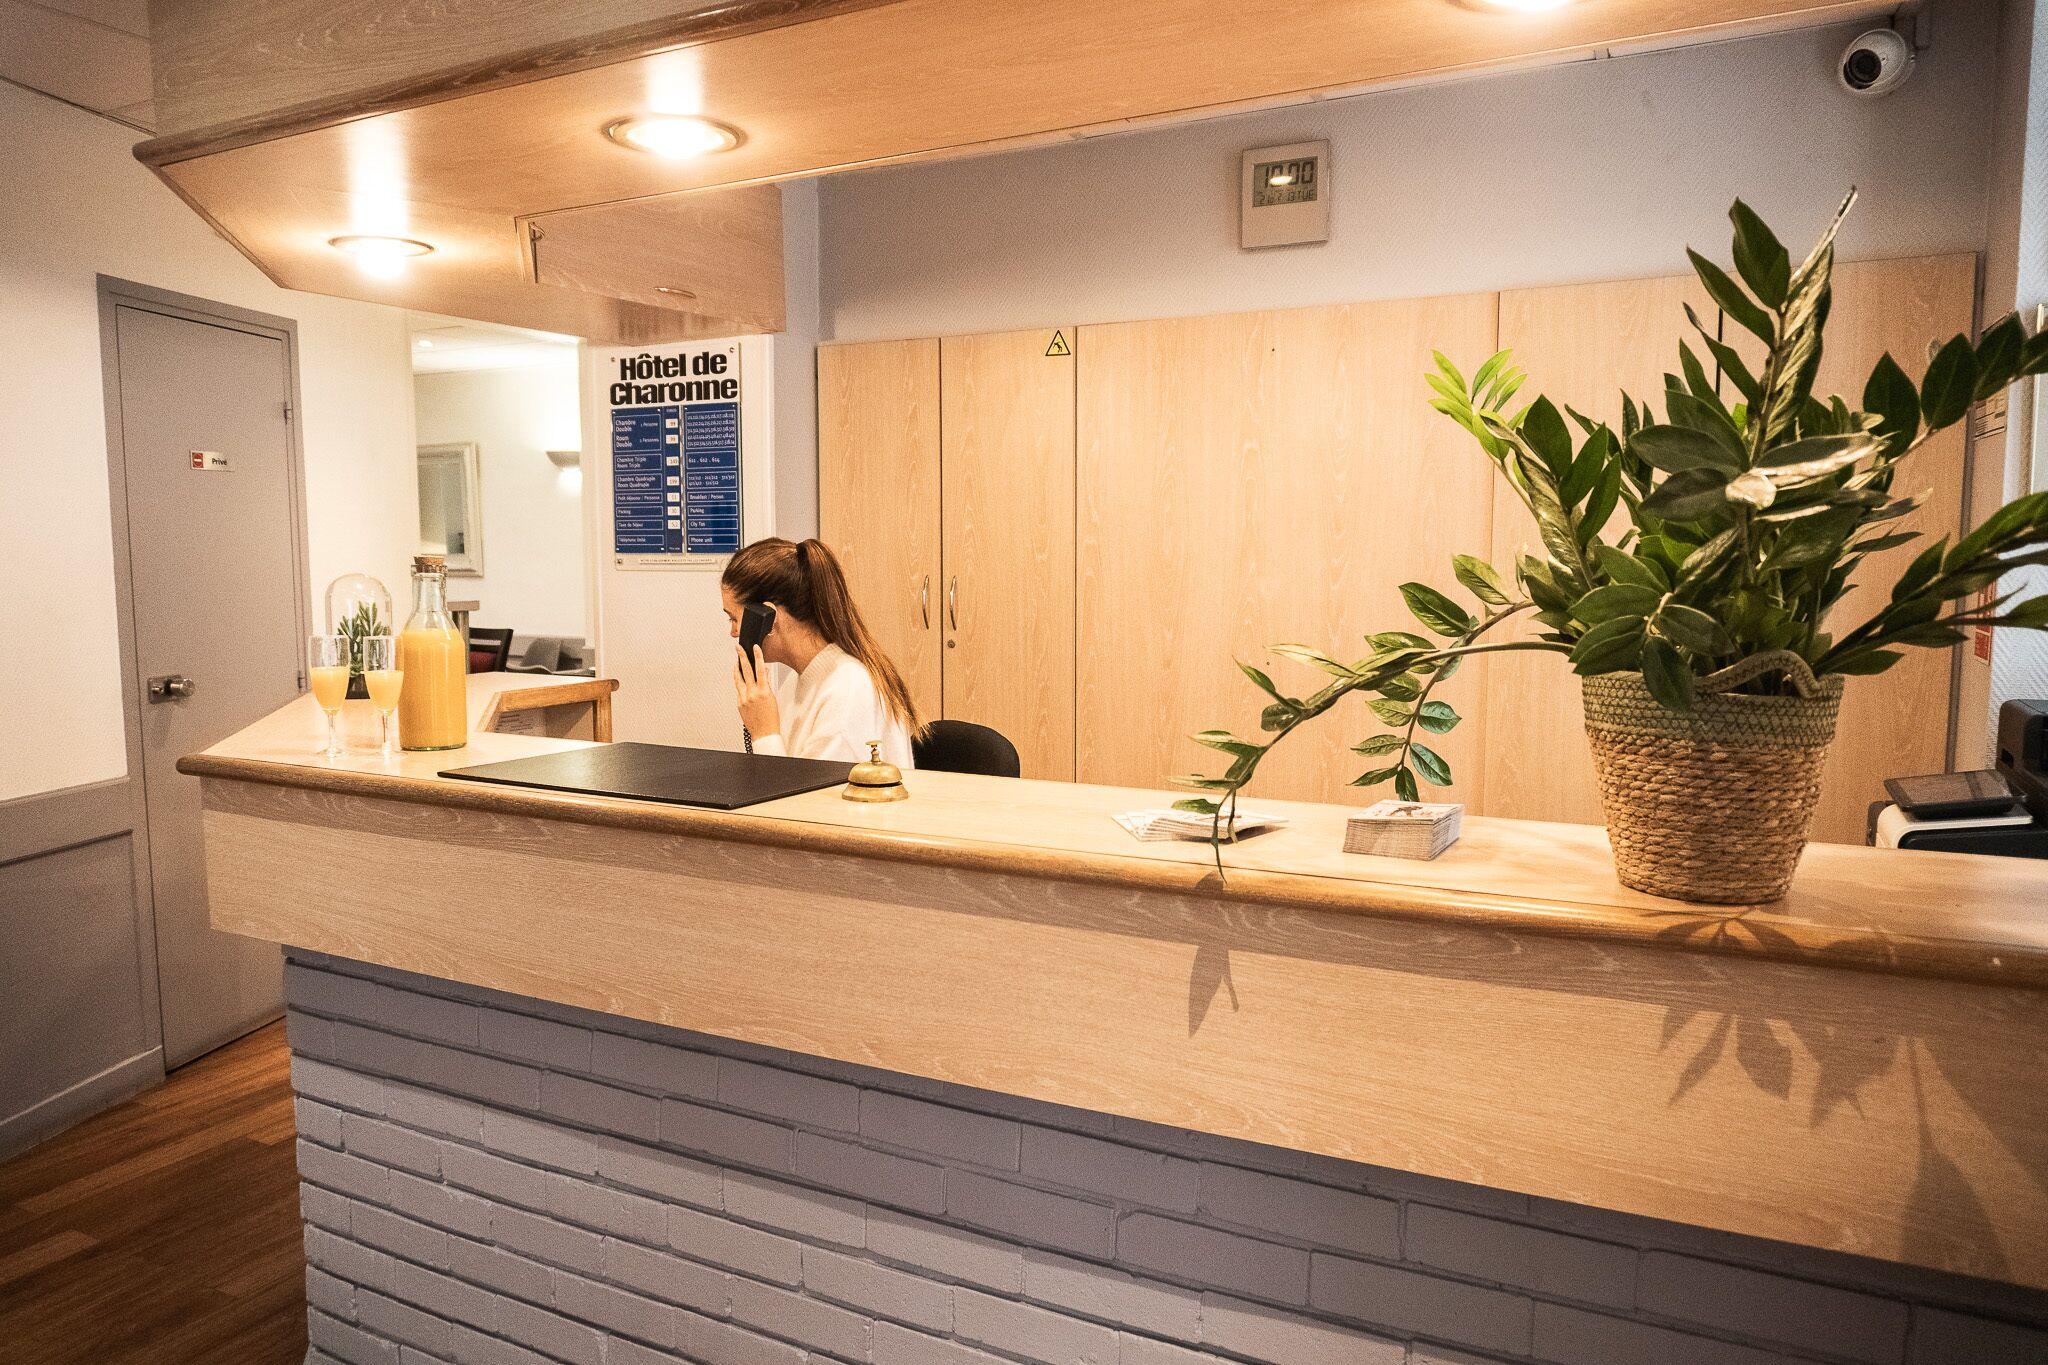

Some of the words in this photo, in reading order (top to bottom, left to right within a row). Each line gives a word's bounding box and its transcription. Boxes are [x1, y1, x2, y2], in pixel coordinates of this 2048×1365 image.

[620, 353, 686, 381] Hôtel
[692, 351, 727, 376] de
[610, 379, 738, 406] Charonne
